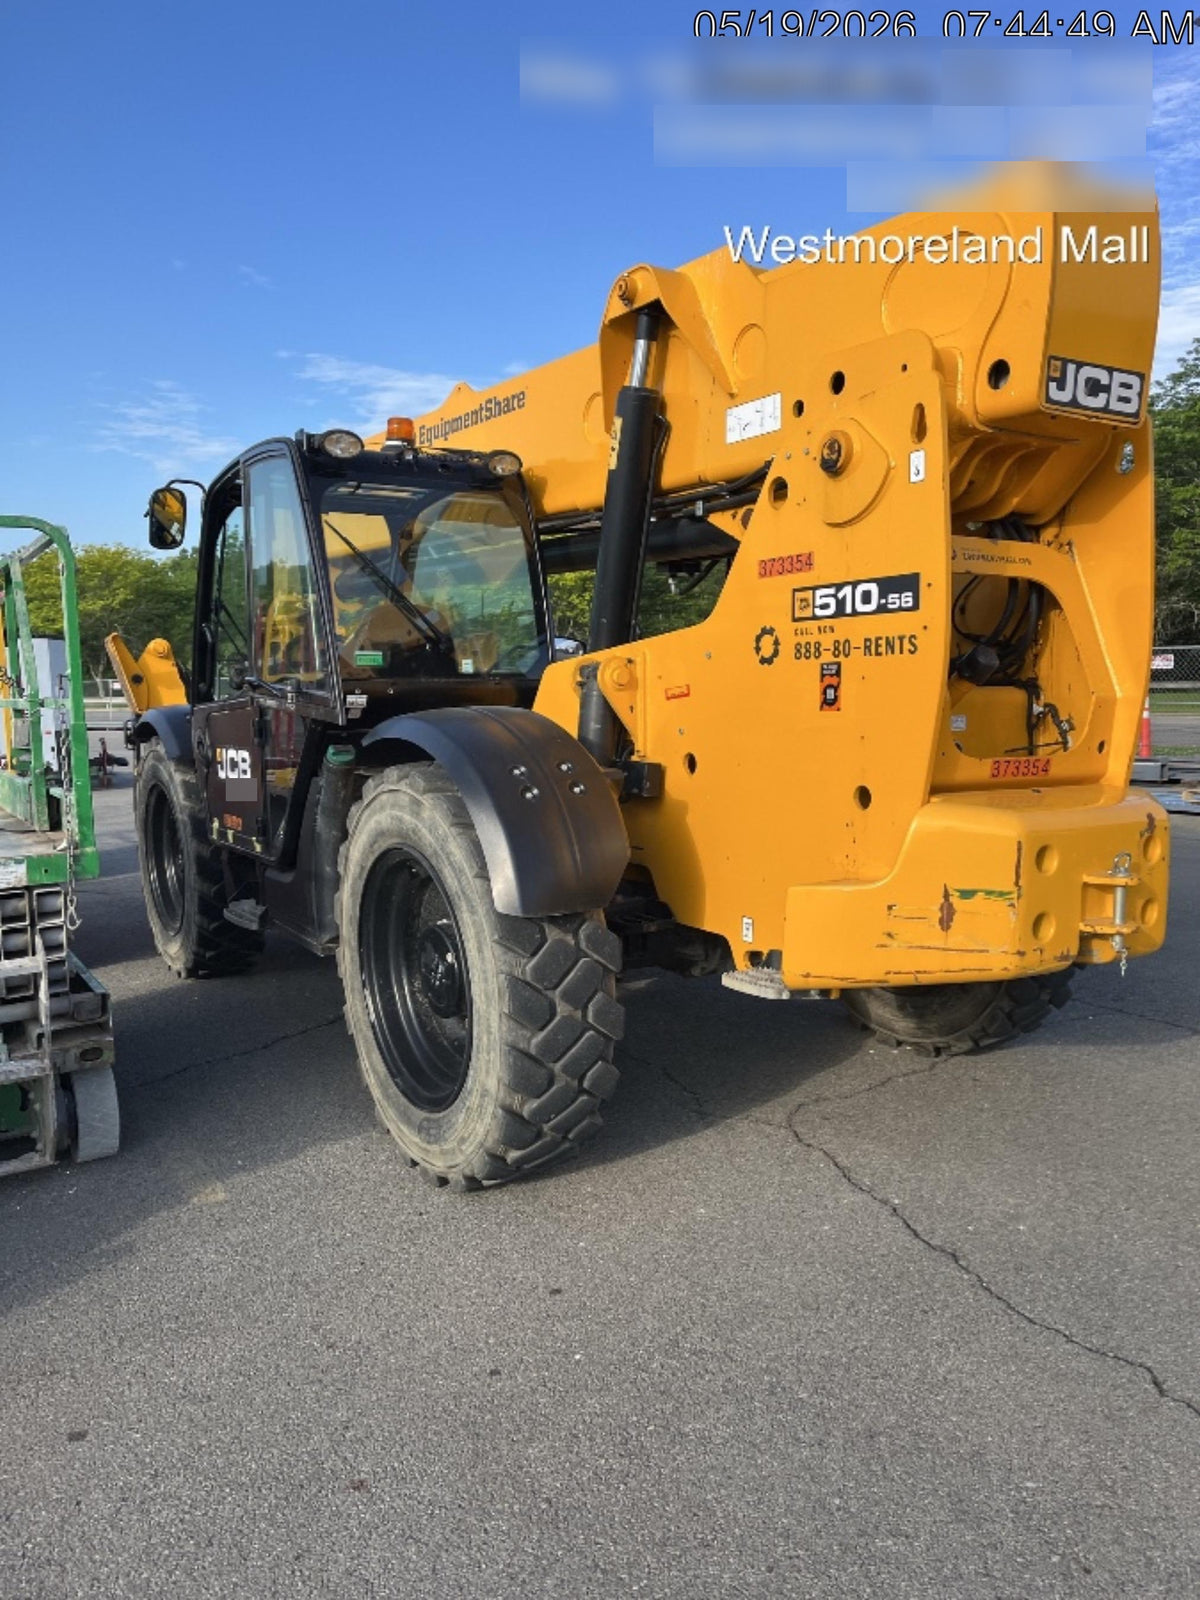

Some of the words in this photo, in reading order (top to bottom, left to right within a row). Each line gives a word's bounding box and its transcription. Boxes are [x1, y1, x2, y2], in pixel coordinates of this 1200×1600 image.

[1048, 361, 1141, 413] JCB
[419, 390, 525, 446] EquipmentShare
[758, 552, 813, 577] 373354
[813, 582, 913, 617] 510-56
[794, 634, 918, 661] 888-80-RENTS
[217, 748, 251, 779] JCB
[992, 759, 1050, 778] 373354
